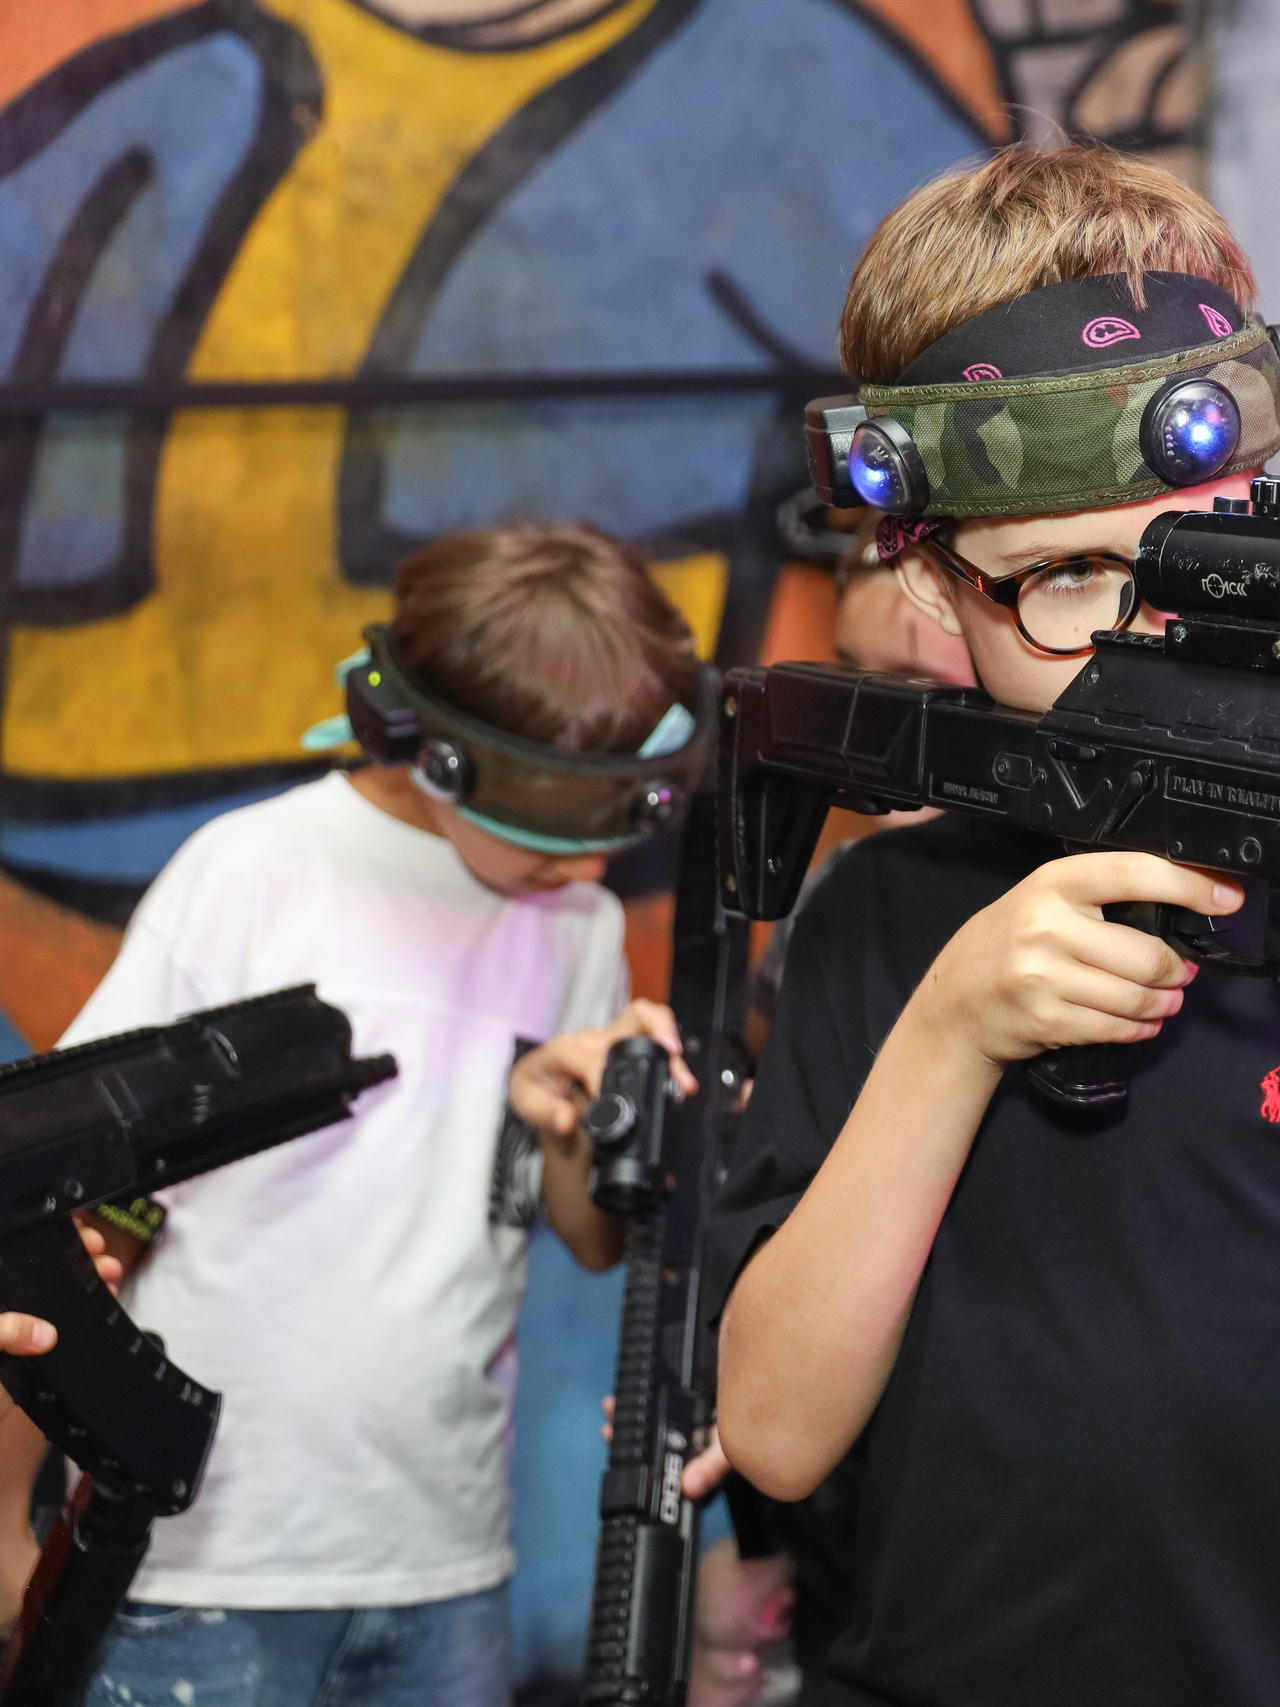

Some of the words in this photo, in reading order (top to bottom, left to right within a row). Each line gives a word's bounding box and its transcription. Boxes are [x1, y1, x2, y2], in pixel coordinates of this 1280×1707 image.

[1263, 505, 1268, 514] 3
[1172, 775, 1206, 797] PLAY
[1208, 782, 1224, 800] IN
